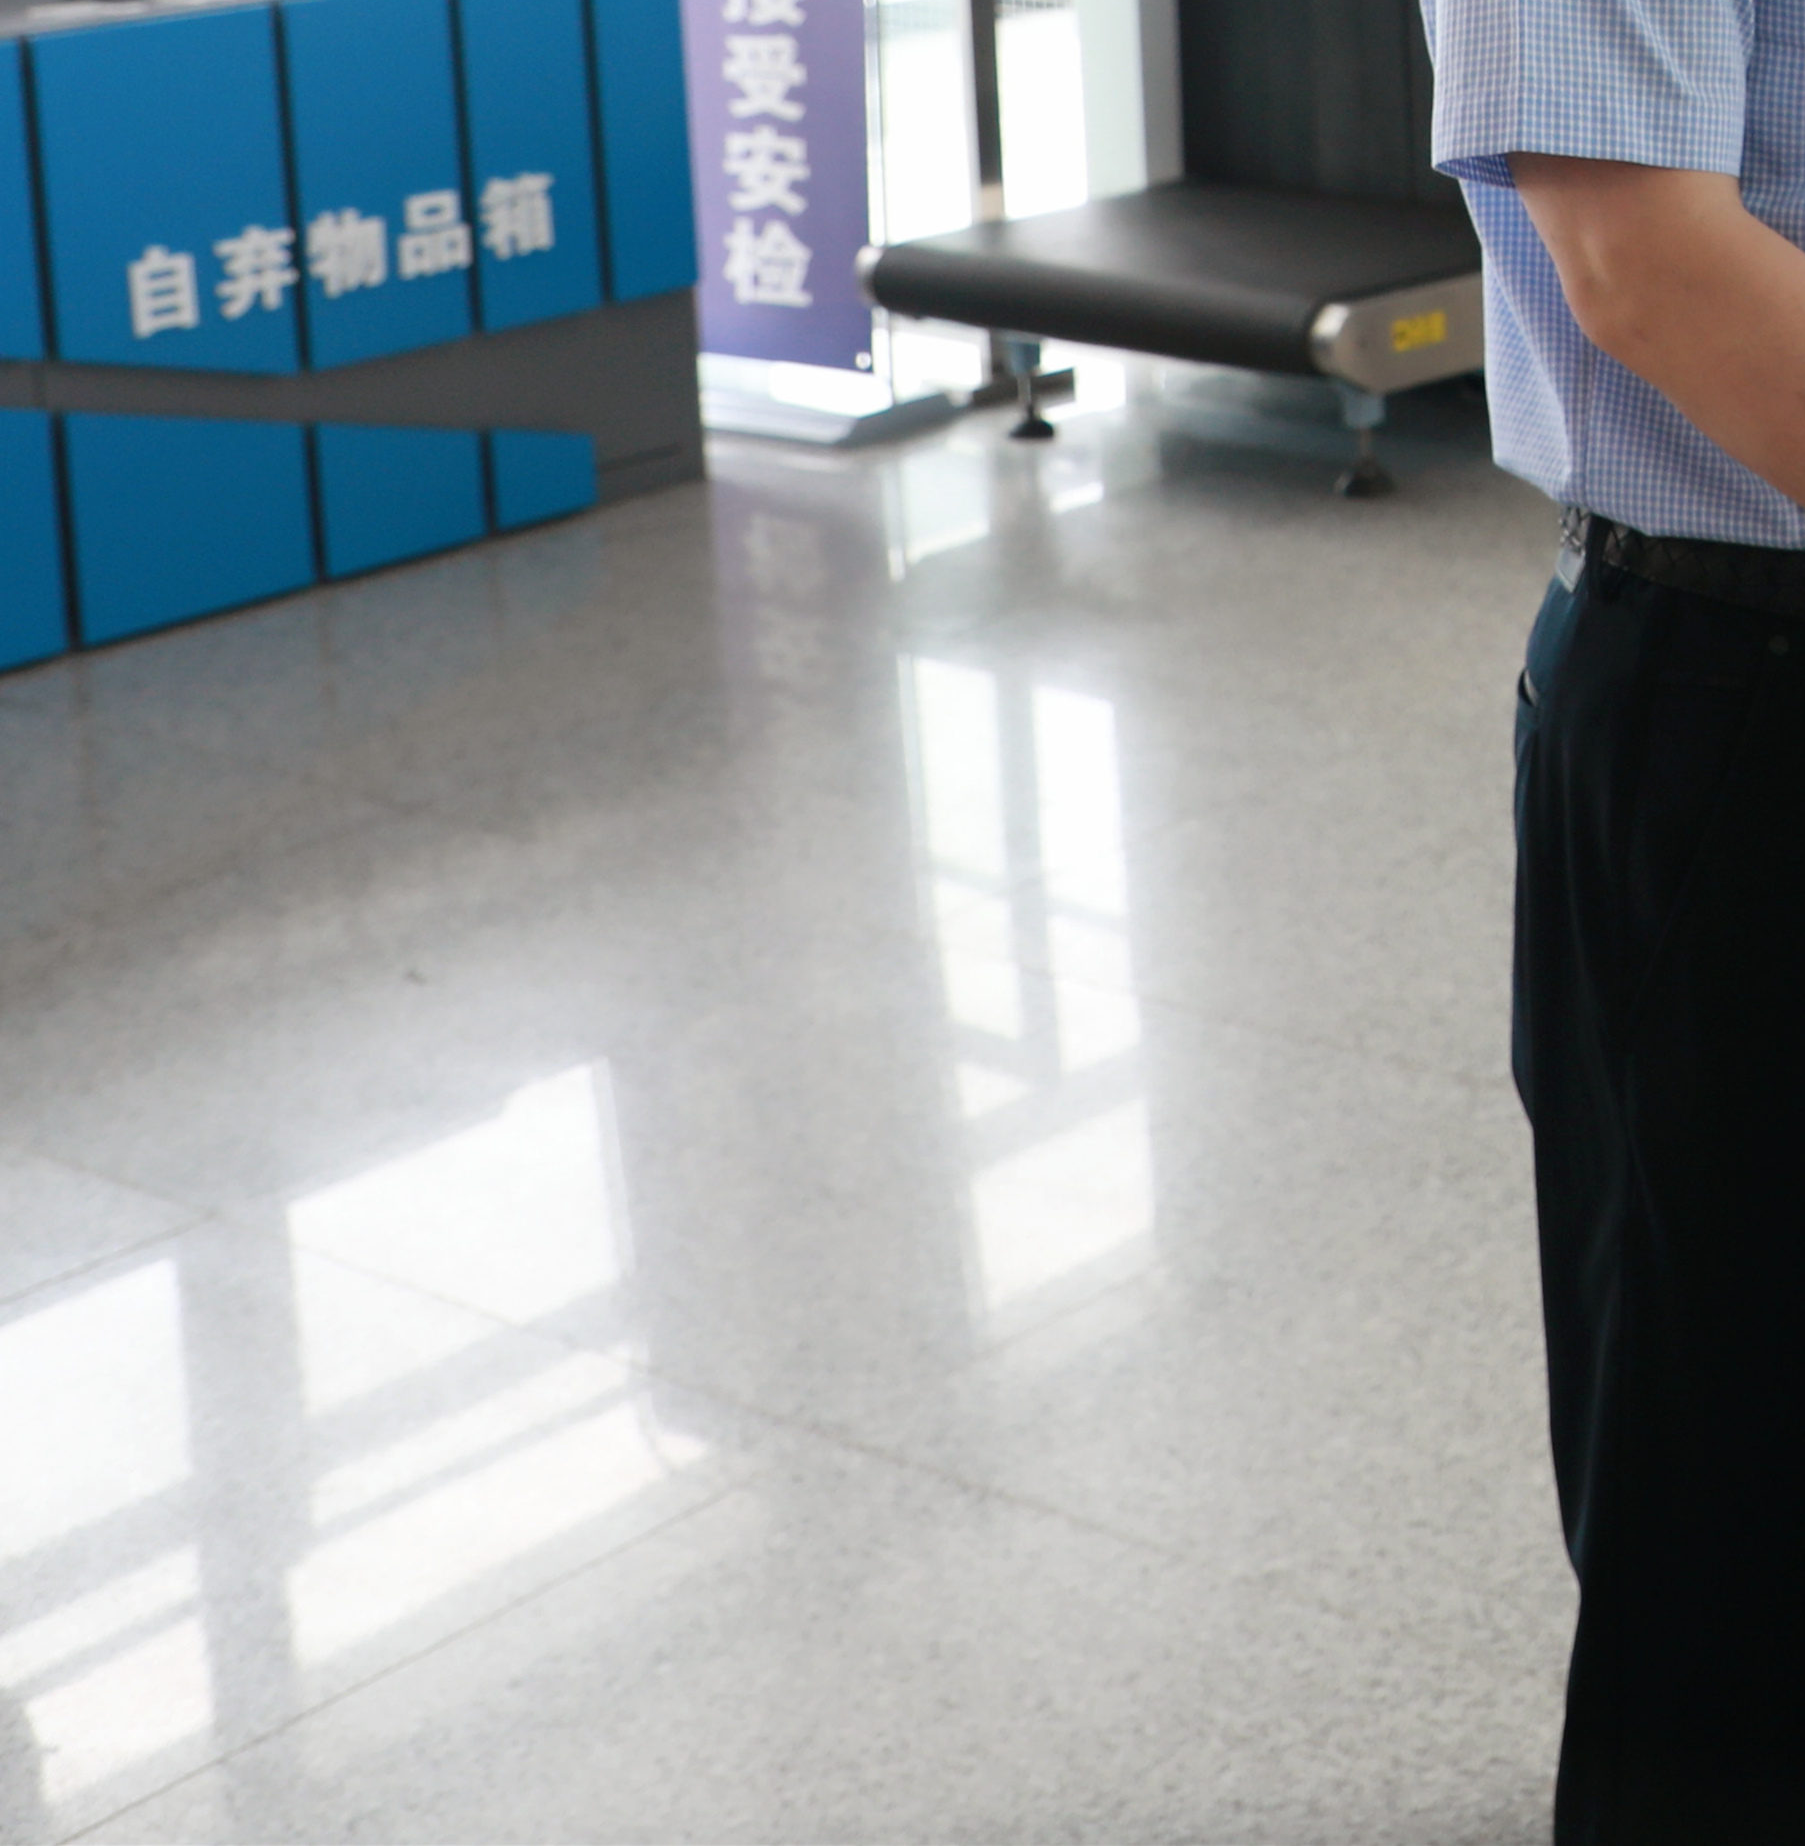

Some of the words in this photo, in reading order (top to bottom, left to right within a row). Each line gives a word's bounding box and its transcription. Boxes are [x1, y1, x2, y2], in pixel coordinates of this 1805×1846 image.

[126, 171, 556, 340] 自弃物品箱
